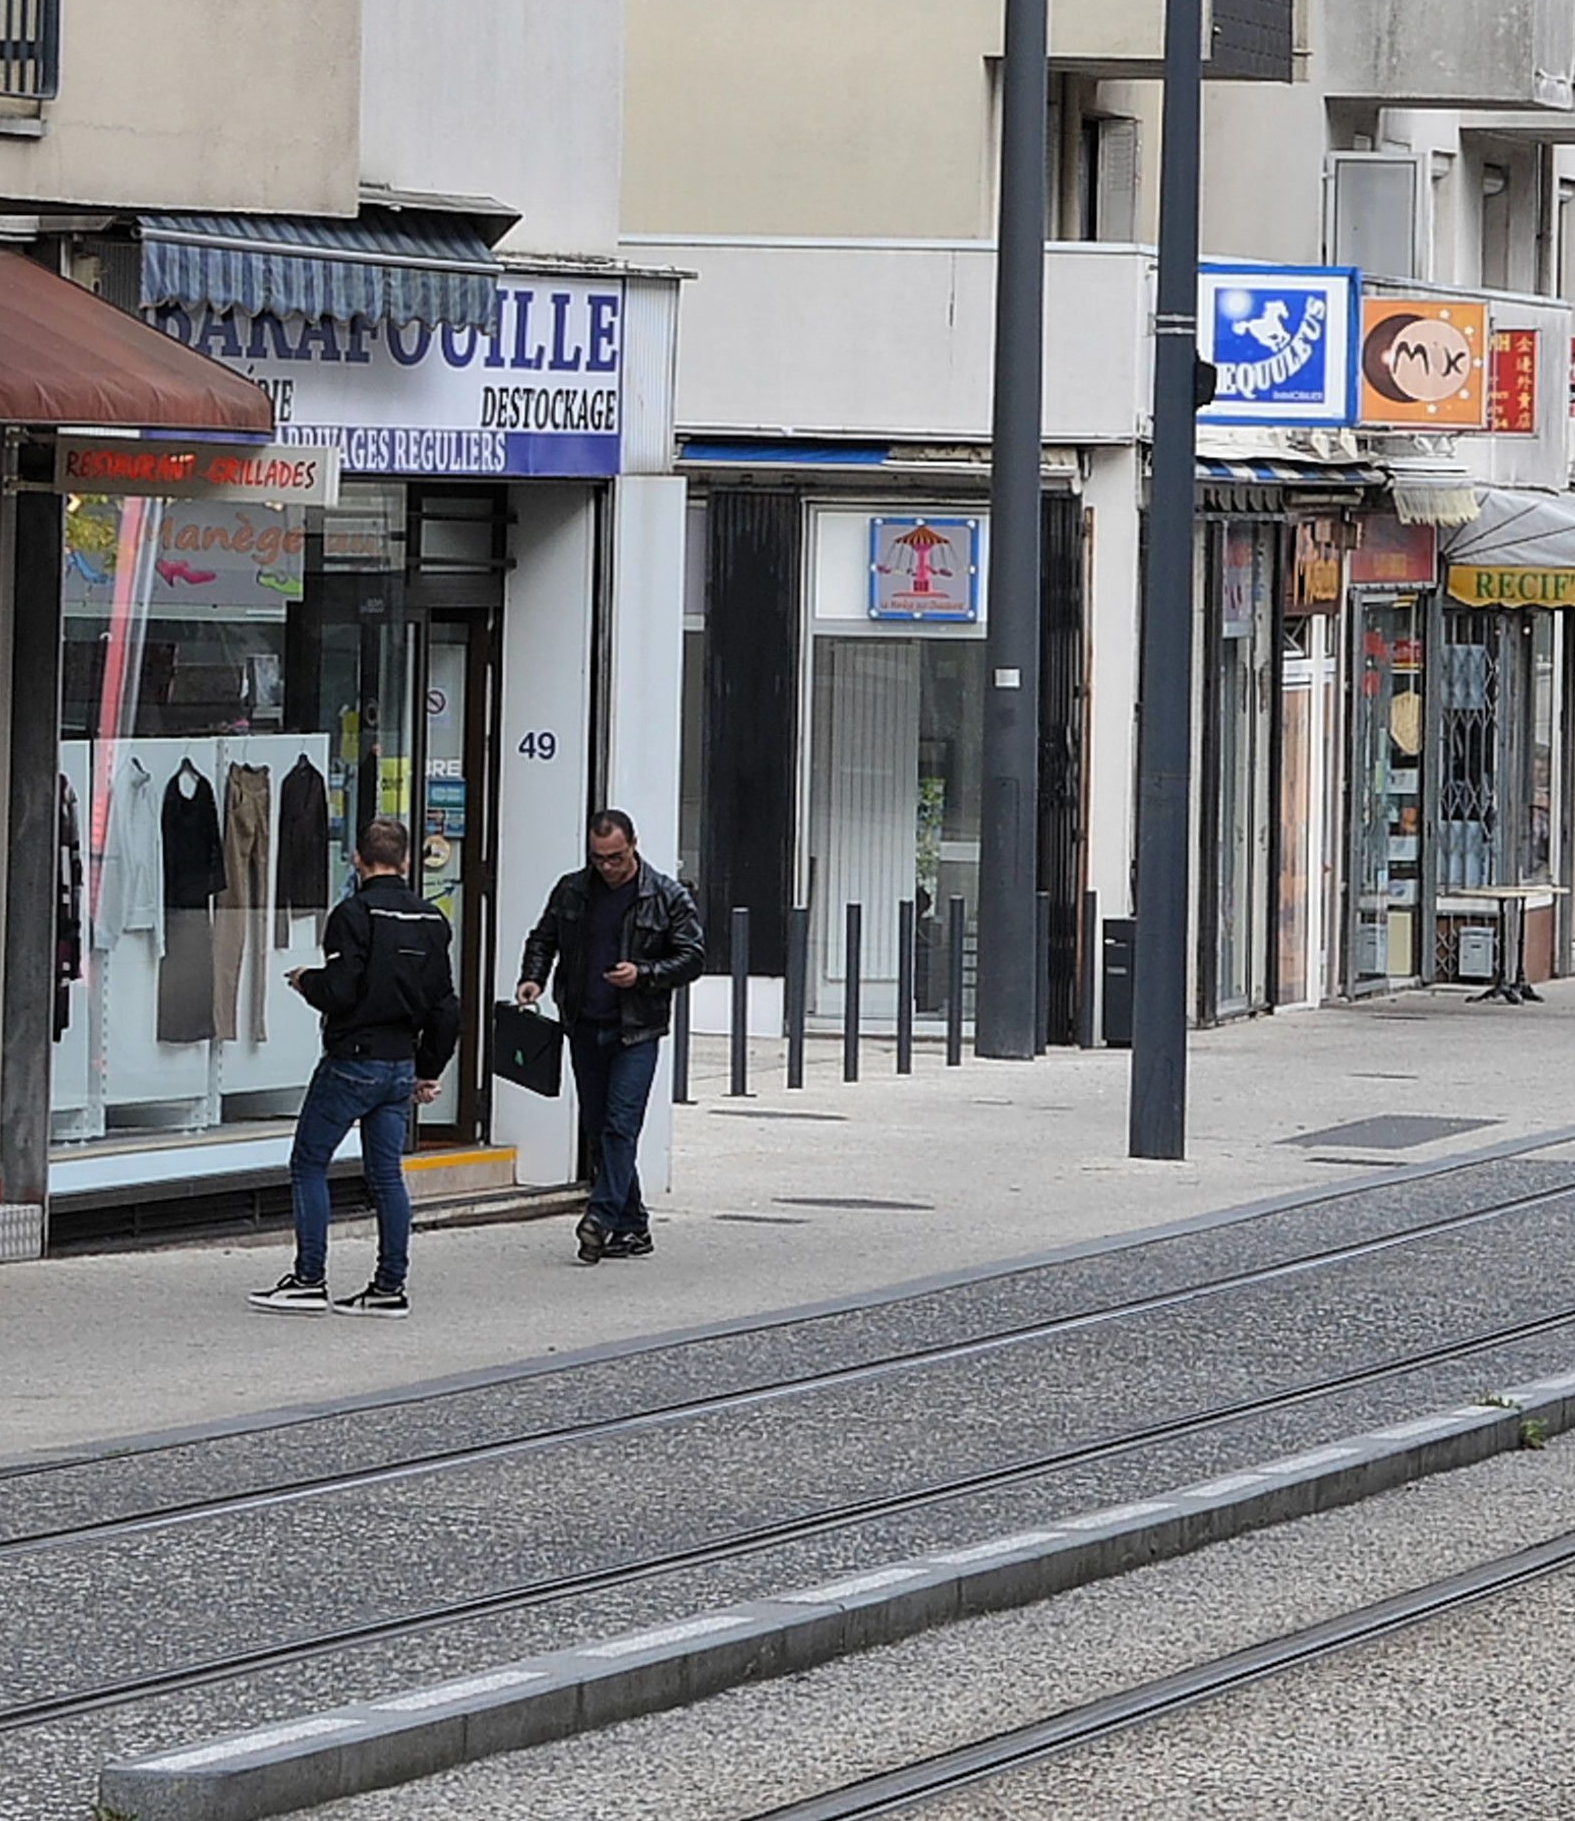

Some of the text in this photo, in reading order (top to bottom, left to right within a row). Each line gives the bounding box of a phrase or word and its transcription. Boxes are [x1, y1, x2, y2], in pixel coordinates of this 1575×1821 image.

[481, 386, 616, 431] DESTOCKAGE
[66, 451, 317, 489] RESTAURANT GRILLADES
[393, 431, 507, 473] REGULIERS
[518, 732, 557, 760] 49
